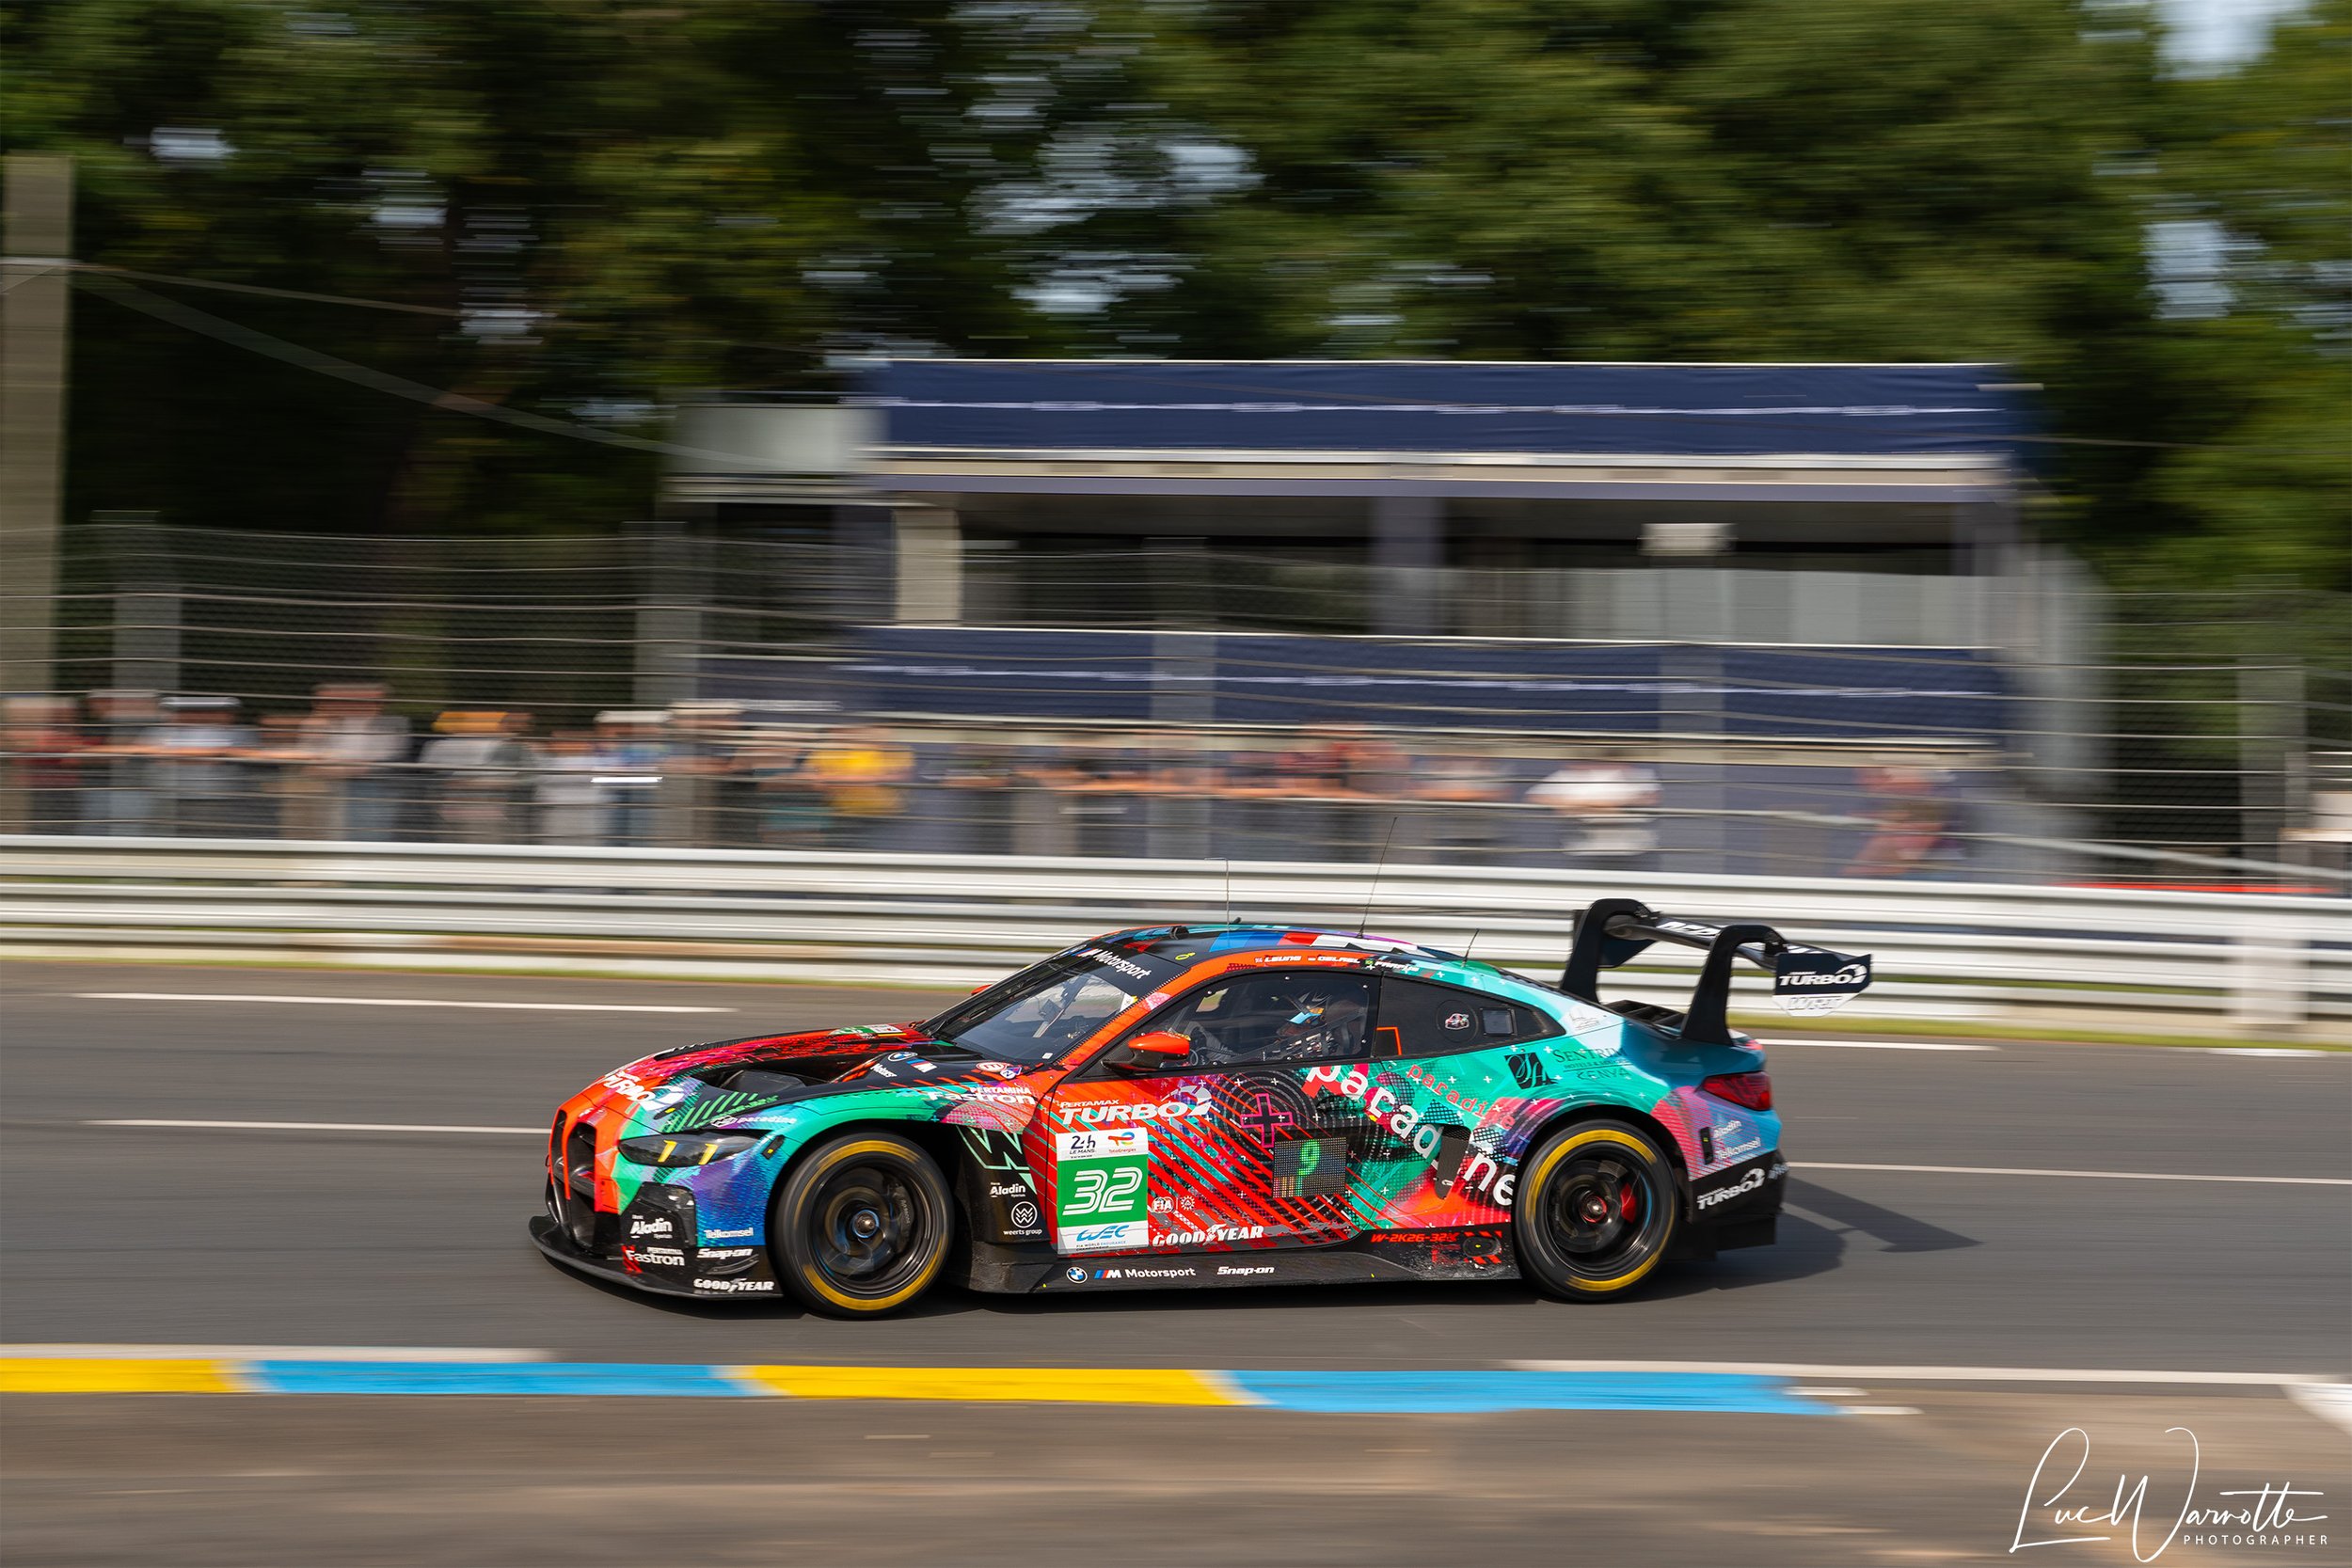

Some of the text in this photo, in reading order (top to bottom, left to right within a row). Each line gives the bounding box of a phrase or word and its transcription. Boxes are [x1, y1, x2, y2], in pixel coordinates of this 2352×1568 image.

[1093, 950, 1152, 979] Motorsport
[971, 1085, 1033, 1095] PERTAMINA
[927, 1090, 1036, 1105] Fastron
[1060, 1099, 1120, 1108] PERTAMAX
[1306, 1064, 1517, 1206] paradne
[989, 1183, 1026, 1196] Aladin
[1062, 1166, 1143, 1216] 32
[1153, 1198, 1173, 1212] FIA
[629, 1217, 673, 1234] Aladin
[1025, 1228, 1042, 1237] group
[705, 1227, 754, 1239] Telkomsel
[1076, 1224, 1130, 1242] WEC
[1152, 1224, 1264, 1247] GOODYEAR
[625, 1249, 685, 1266] Fastron
[696, 1248, 753, 1259] Snap-on
[1125, 1267, 1197, 1279] Motorsport
[1216, 1266, 1275, 1276] Snap-on
[693, 1277, 775, 1292] GOODYEAR
